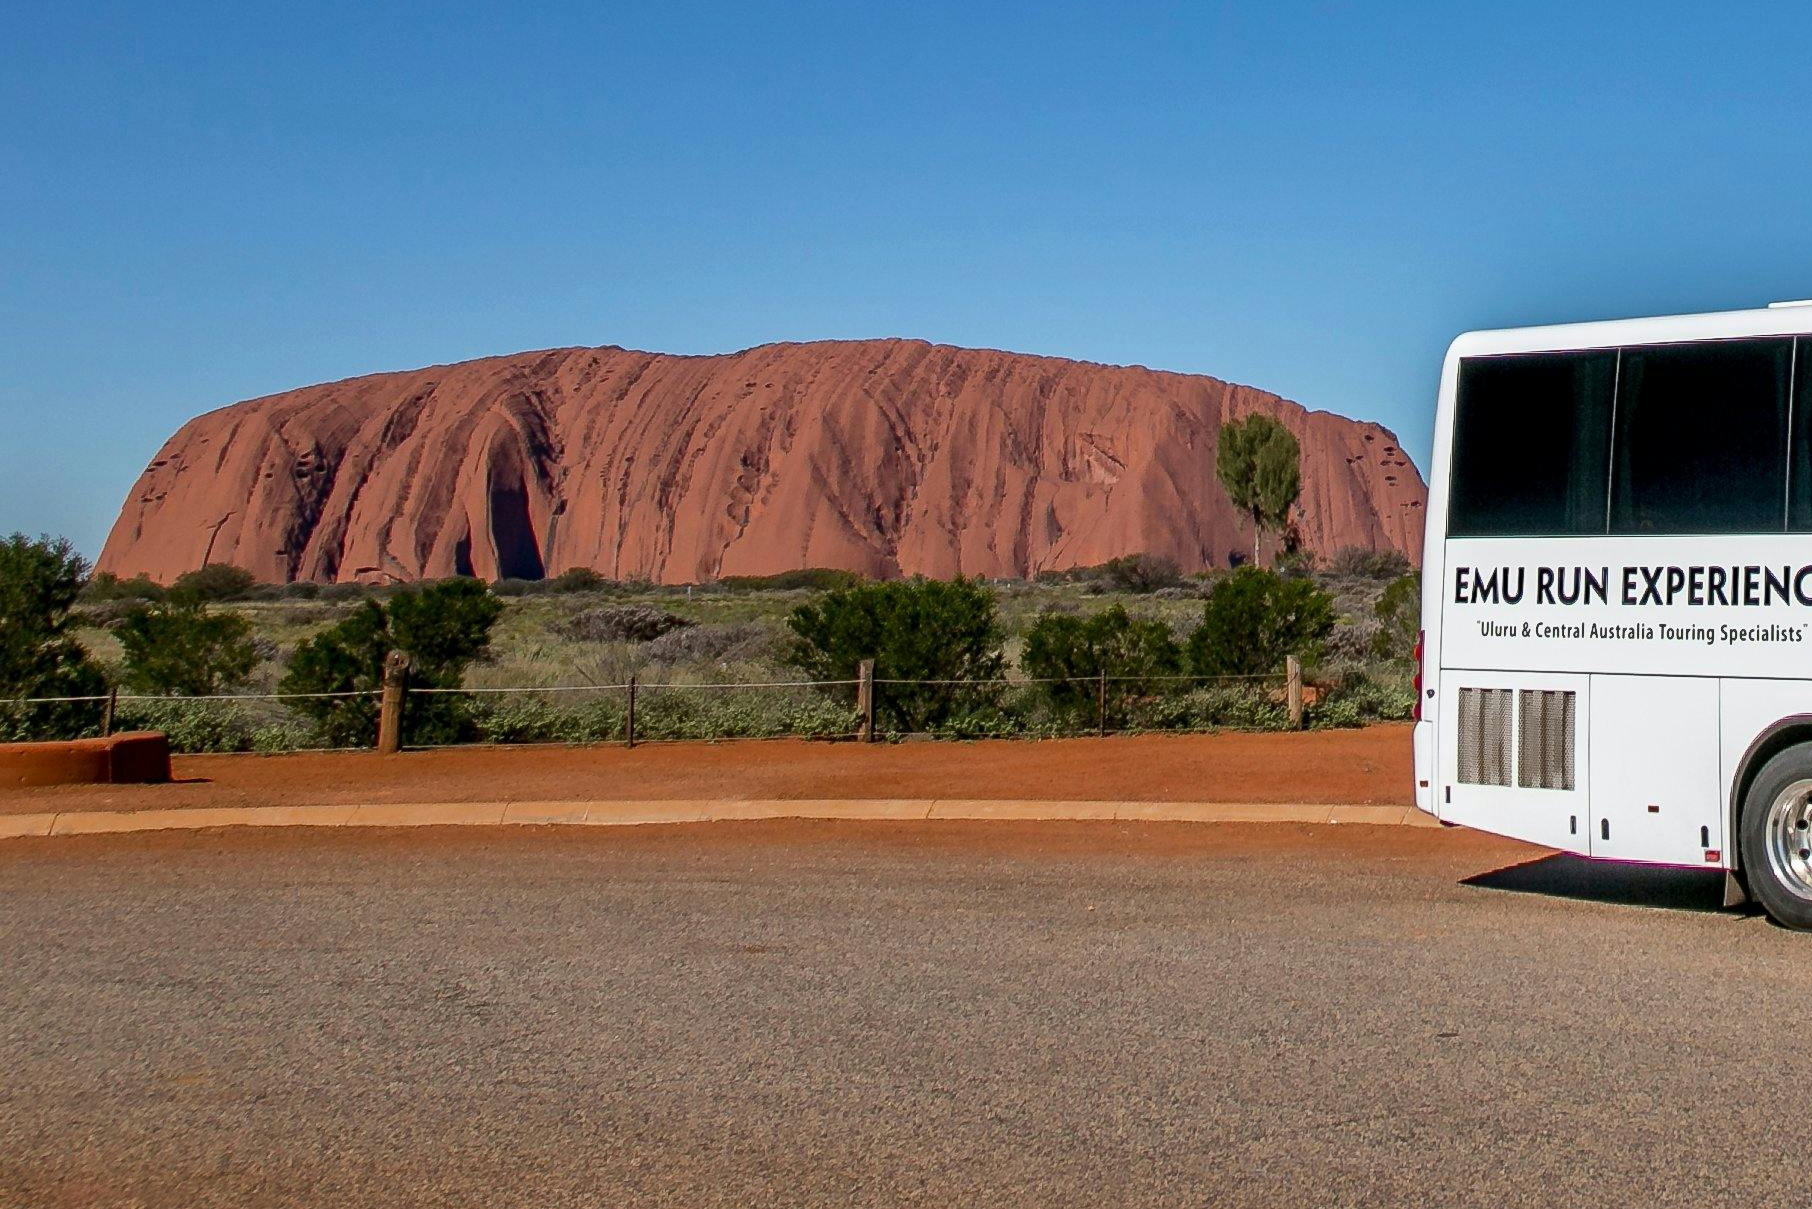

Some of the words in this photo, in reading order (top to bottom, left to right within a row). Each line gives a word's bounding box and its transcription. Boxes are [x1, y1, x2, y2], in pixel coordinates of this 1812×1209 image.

[1454, 566, 1525, 605] EMU
[1536, 566, 1609, 606] RUN
[1521, 621, 1531, 638] &
[1535, 621, 1585, 639] Central
[1589, 622, 1654, 640] Australia
[1658, 623, 1715, 645] Touring
